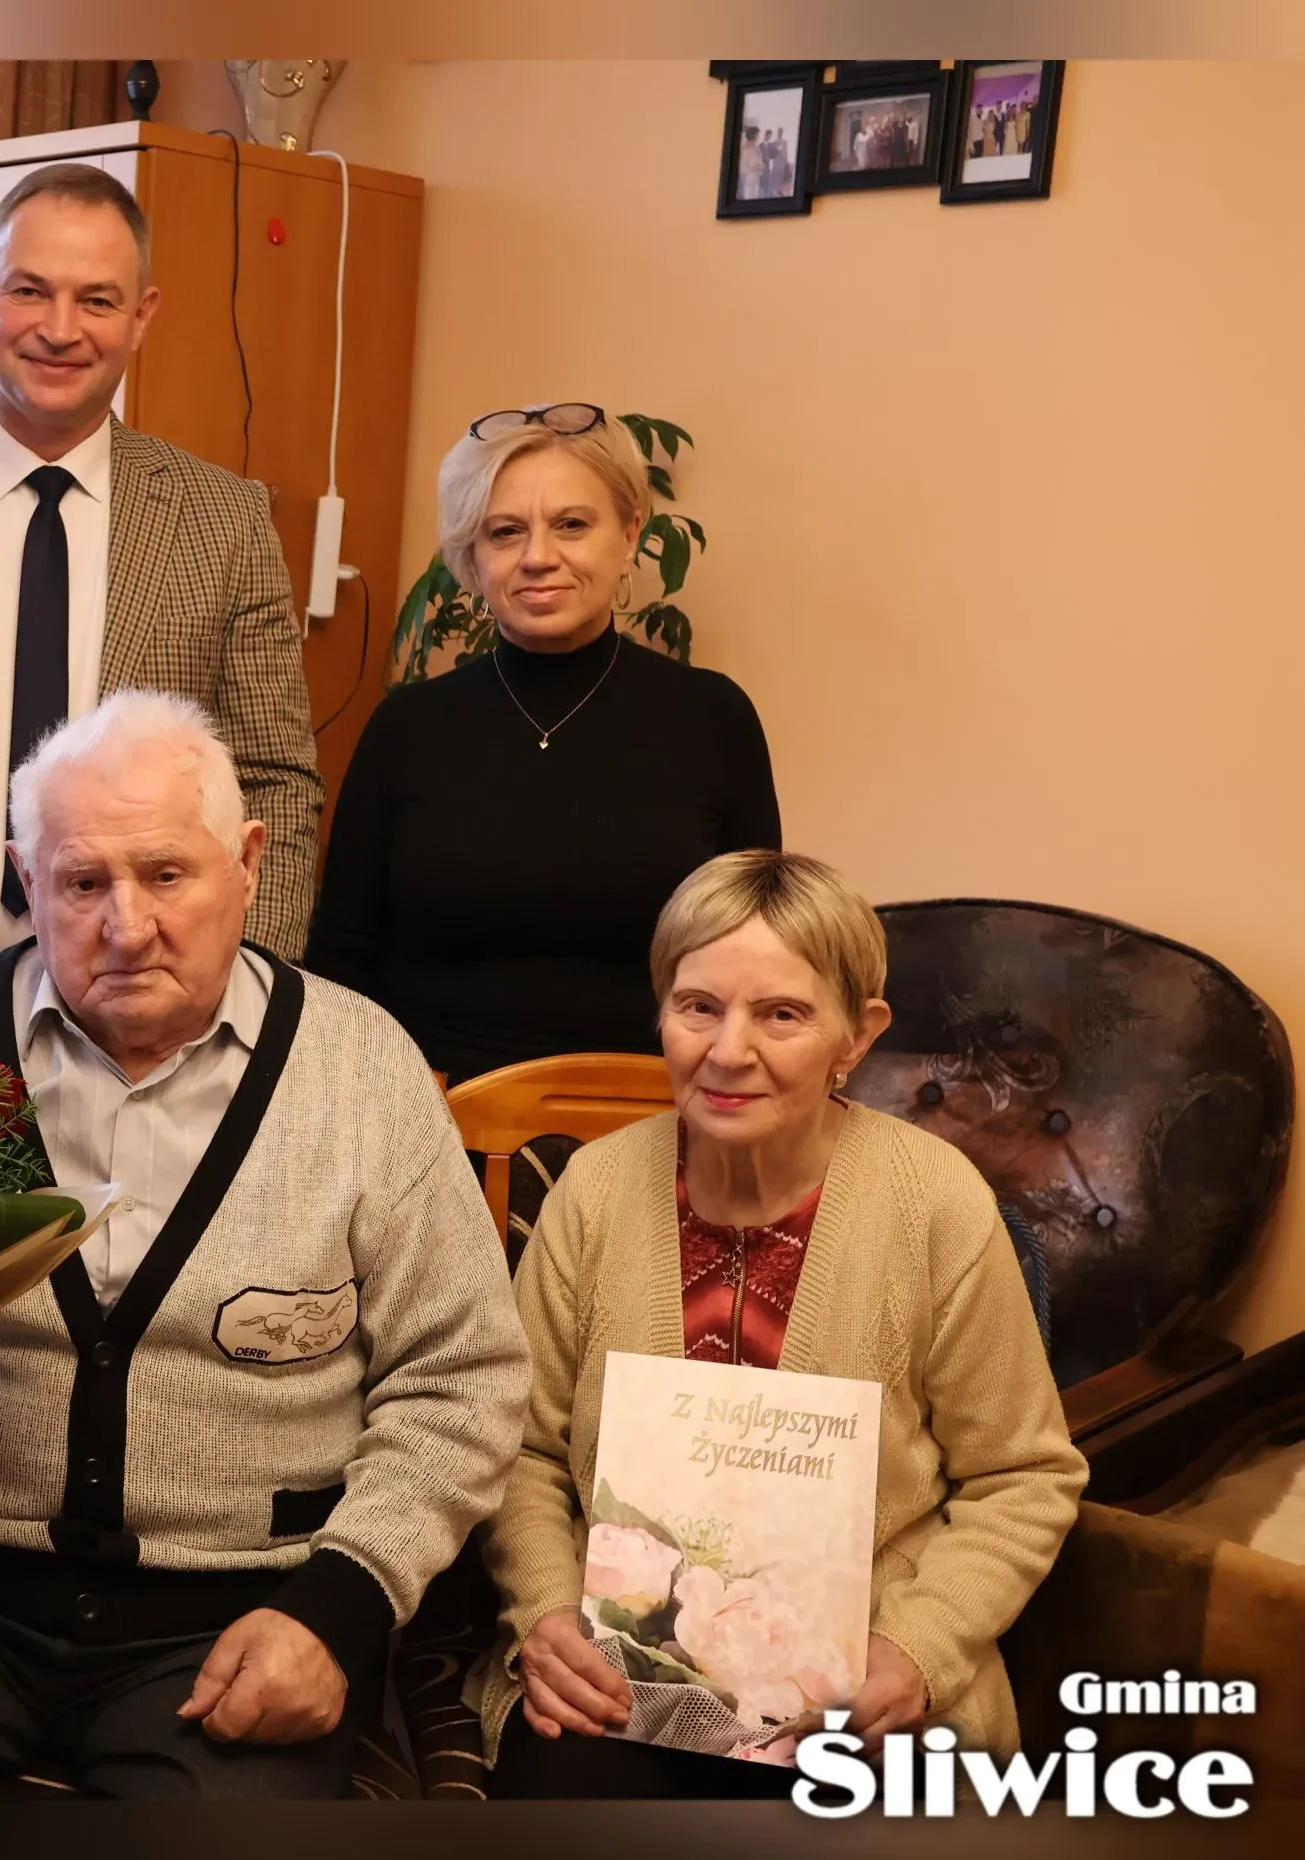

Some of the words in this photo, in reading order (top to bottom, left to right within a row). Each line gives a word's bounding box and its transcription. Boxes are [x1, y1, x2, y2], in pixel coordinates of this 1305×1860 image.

[234, 1347, 272, 1359] DERBY
[670, 1392, 695, 1419] Z
[704, 1393, 859, 1449] Najlepszymi
[688, 1430, 835, 1480] Życzeniami
